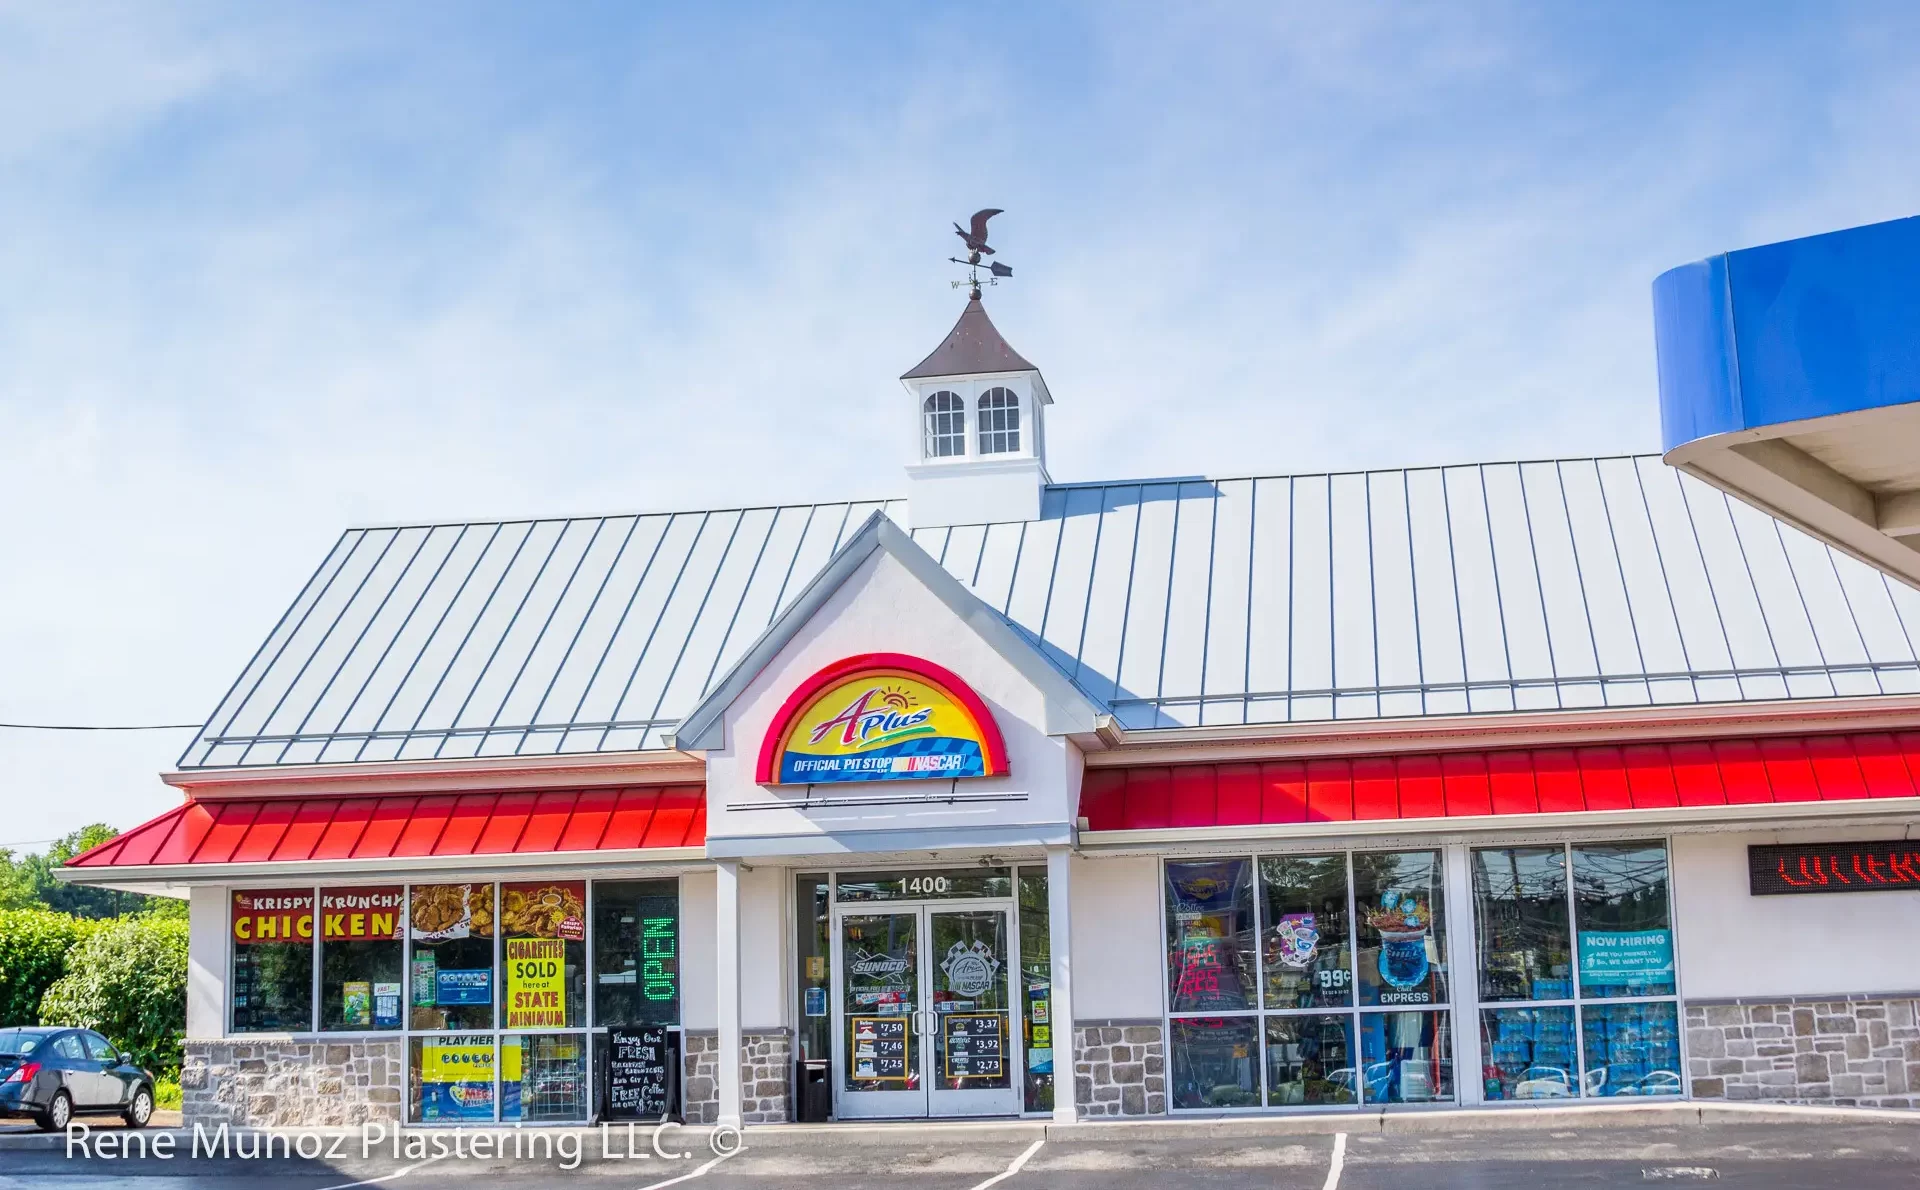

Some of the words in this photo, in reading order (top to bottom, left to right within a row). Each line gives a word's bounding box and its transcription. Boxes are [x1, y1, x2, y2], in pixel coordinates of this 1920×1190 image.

[794, 758, 841, 772] OFFICIAL
[844, 758, 862, 771] PIT
[863, 756, 892, 769] STOP
[914, 753, 962, 771] NASCAR
[899, 877, 947, 894] 1400
[253, 896, 314, 911] KRISPY
[323, 893, 404, 911] KRUNCHY
[234, 913, 393, 940] CHICKEN
[1586, 936, 1617, 947] NOW
[1620, 934, 1665, 947] HIRING
[508, 940, 564, 960] CIGARETTES
[643, 917, 675, 1001] OPEN
[855, 961, 905, 972] SUNOCO
[516, 961, 557, 979] SOLD
[523, 980, 541, 989] here
[541, 981, 550, 989] at
[962, 981, 990, 990] NASCAR
[1319, 969, 1351, 988] 99¢
[514, 991, 559, 1008] STATE
[1380, 992, 1429, 1003] EXPRESS
[509, 1010, 564, 1027] MINIMUM
[976, 1019, 998, 1029] $3.37
[881, 1023, 903, 1033] $7.50
[438, 1036, 467, 1046] PLAY
[469, 1035, 494, 1046] HER
[613, 1031, 641, 1046] Enjoy
[881, 1041, 903, 1051] $7.46
[976, 1039, 999, 1049] $3.92
[618, 1046, 656, 1061] FRESH
[881, 1059, 903, 1069] $7.25
[977, 1060, 999, 1070] $2.73
[643, 1076, 650, 1084] A
[611, 1086, 640, 1102] FREE
[641, 1083, 665, 1100] Coffee
